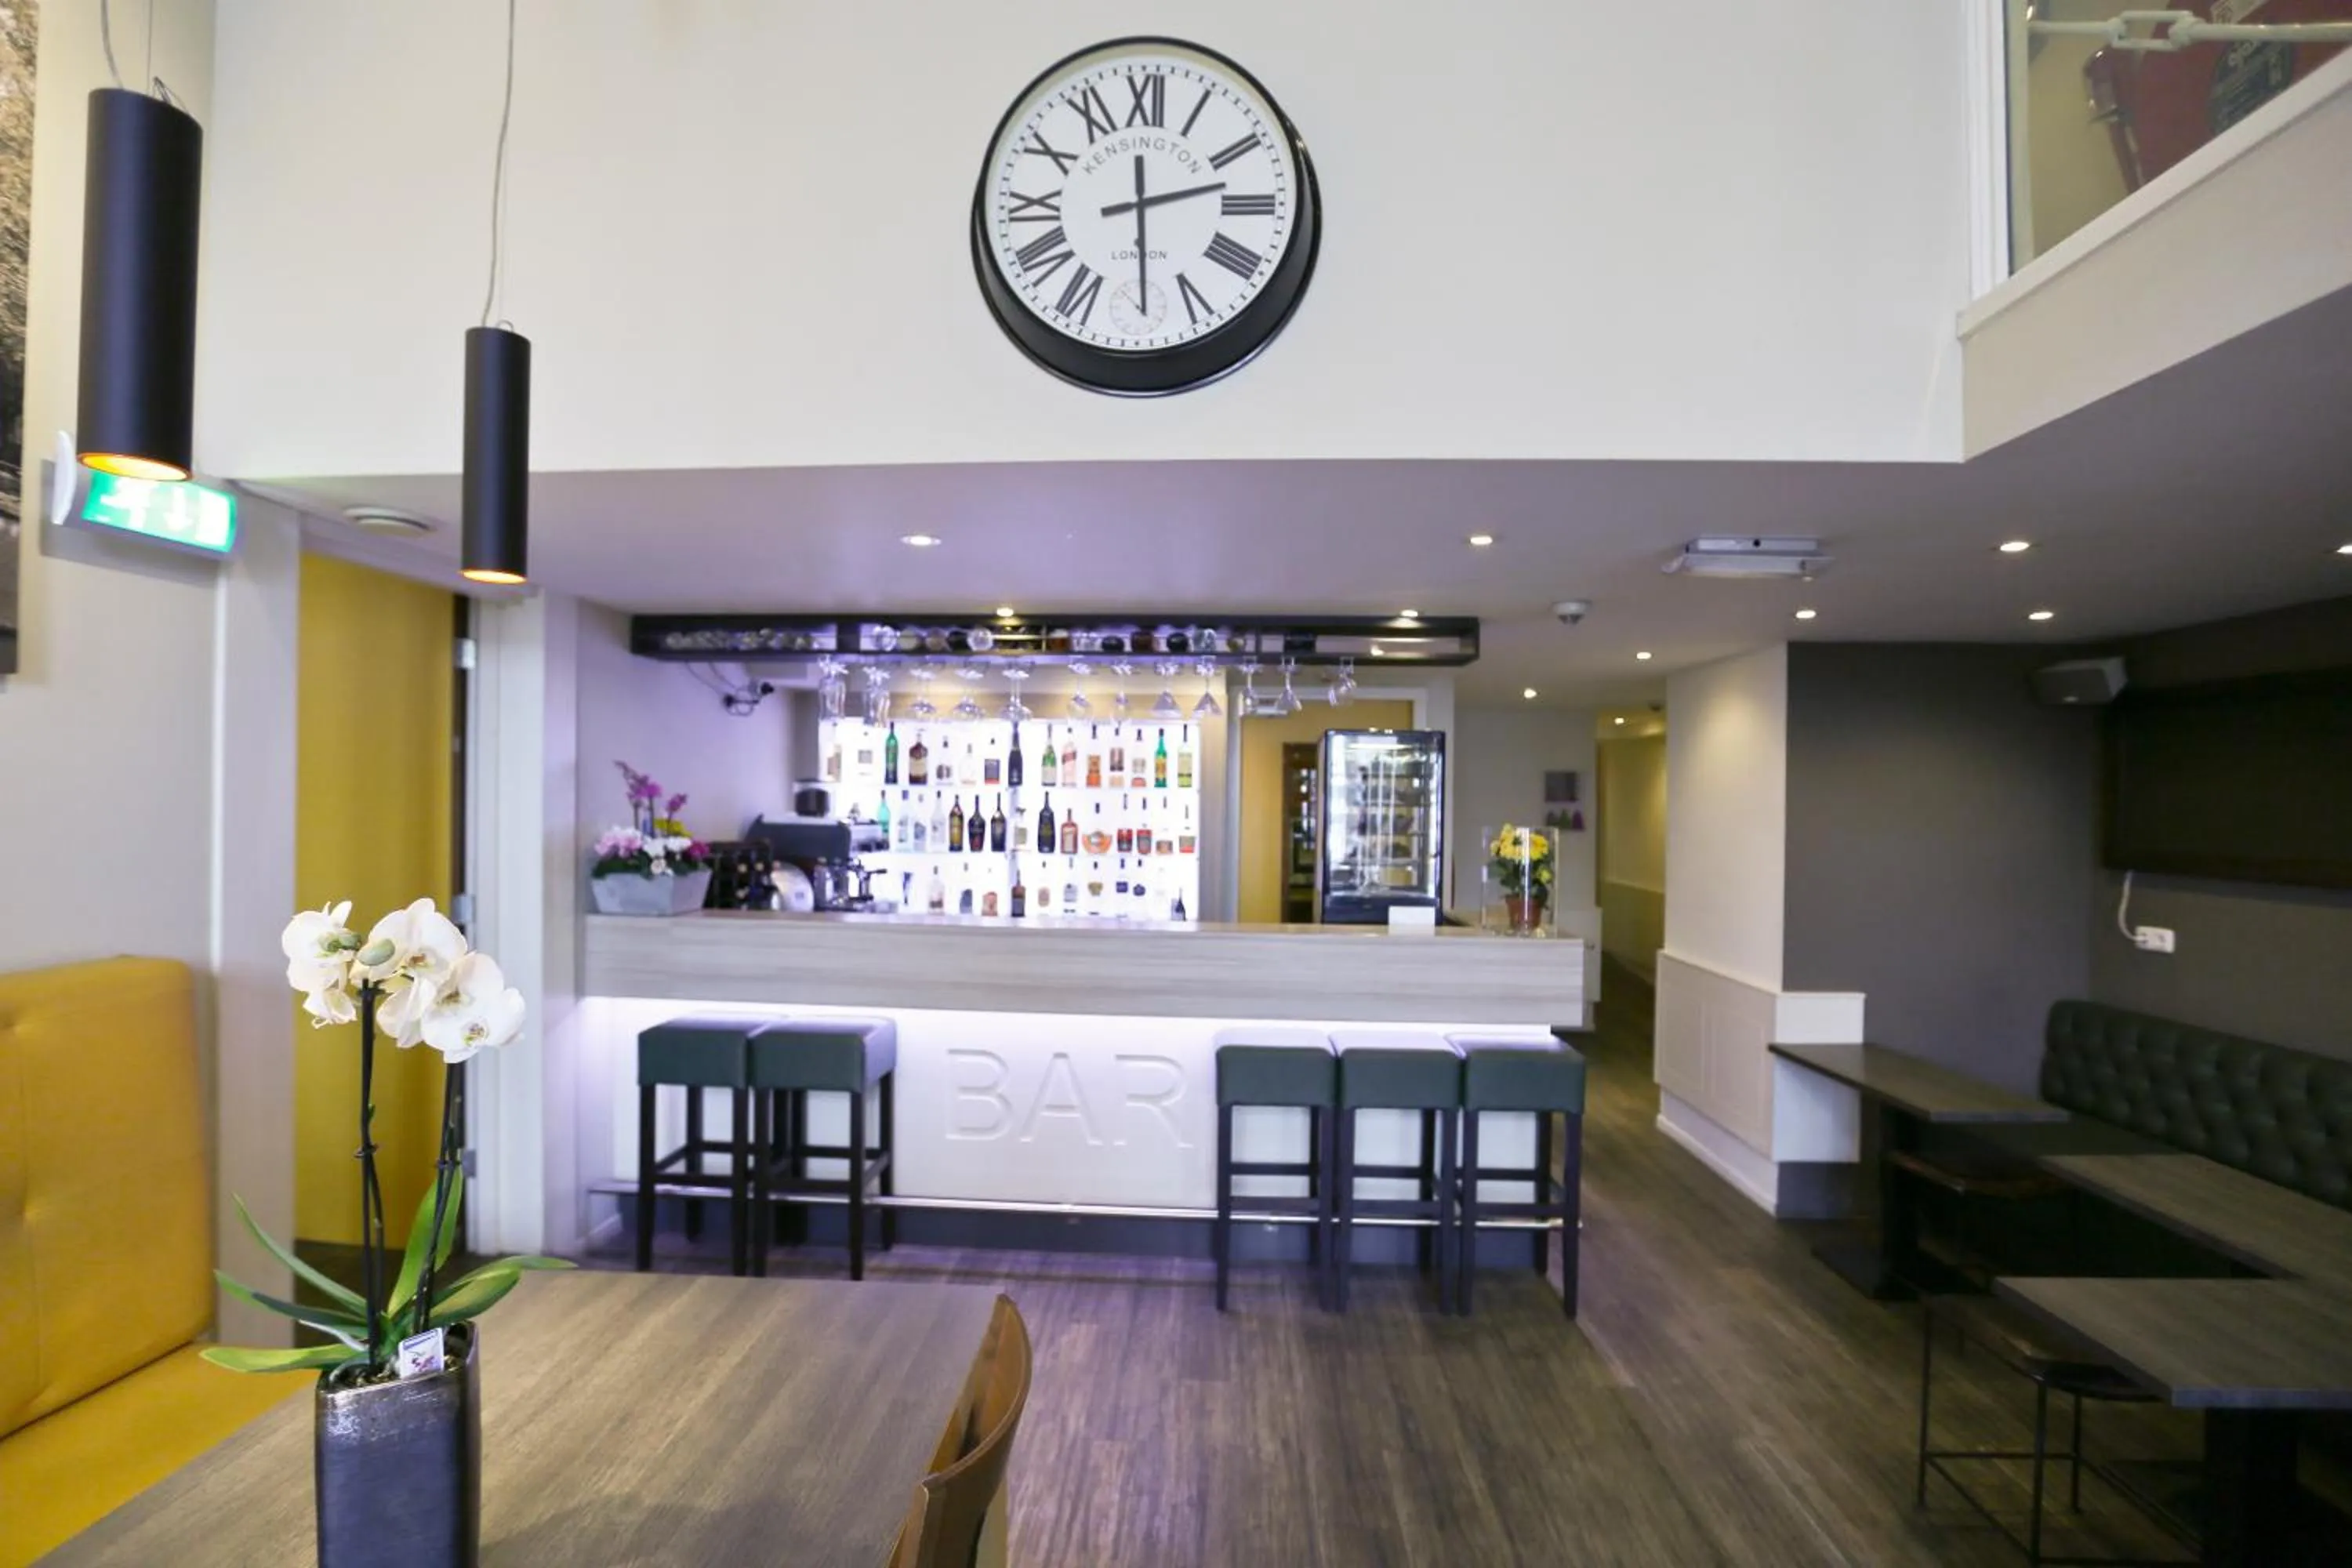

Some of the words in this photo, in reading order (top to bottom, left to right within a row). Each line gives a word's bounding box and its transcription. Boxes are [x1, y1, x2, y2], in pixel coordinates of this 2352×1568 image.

[1082, 136, 1203, 175] KENSINGTON
[1111, 250, 1167, 260] LONON
[946, 1047, 1194, 1148] BAR
